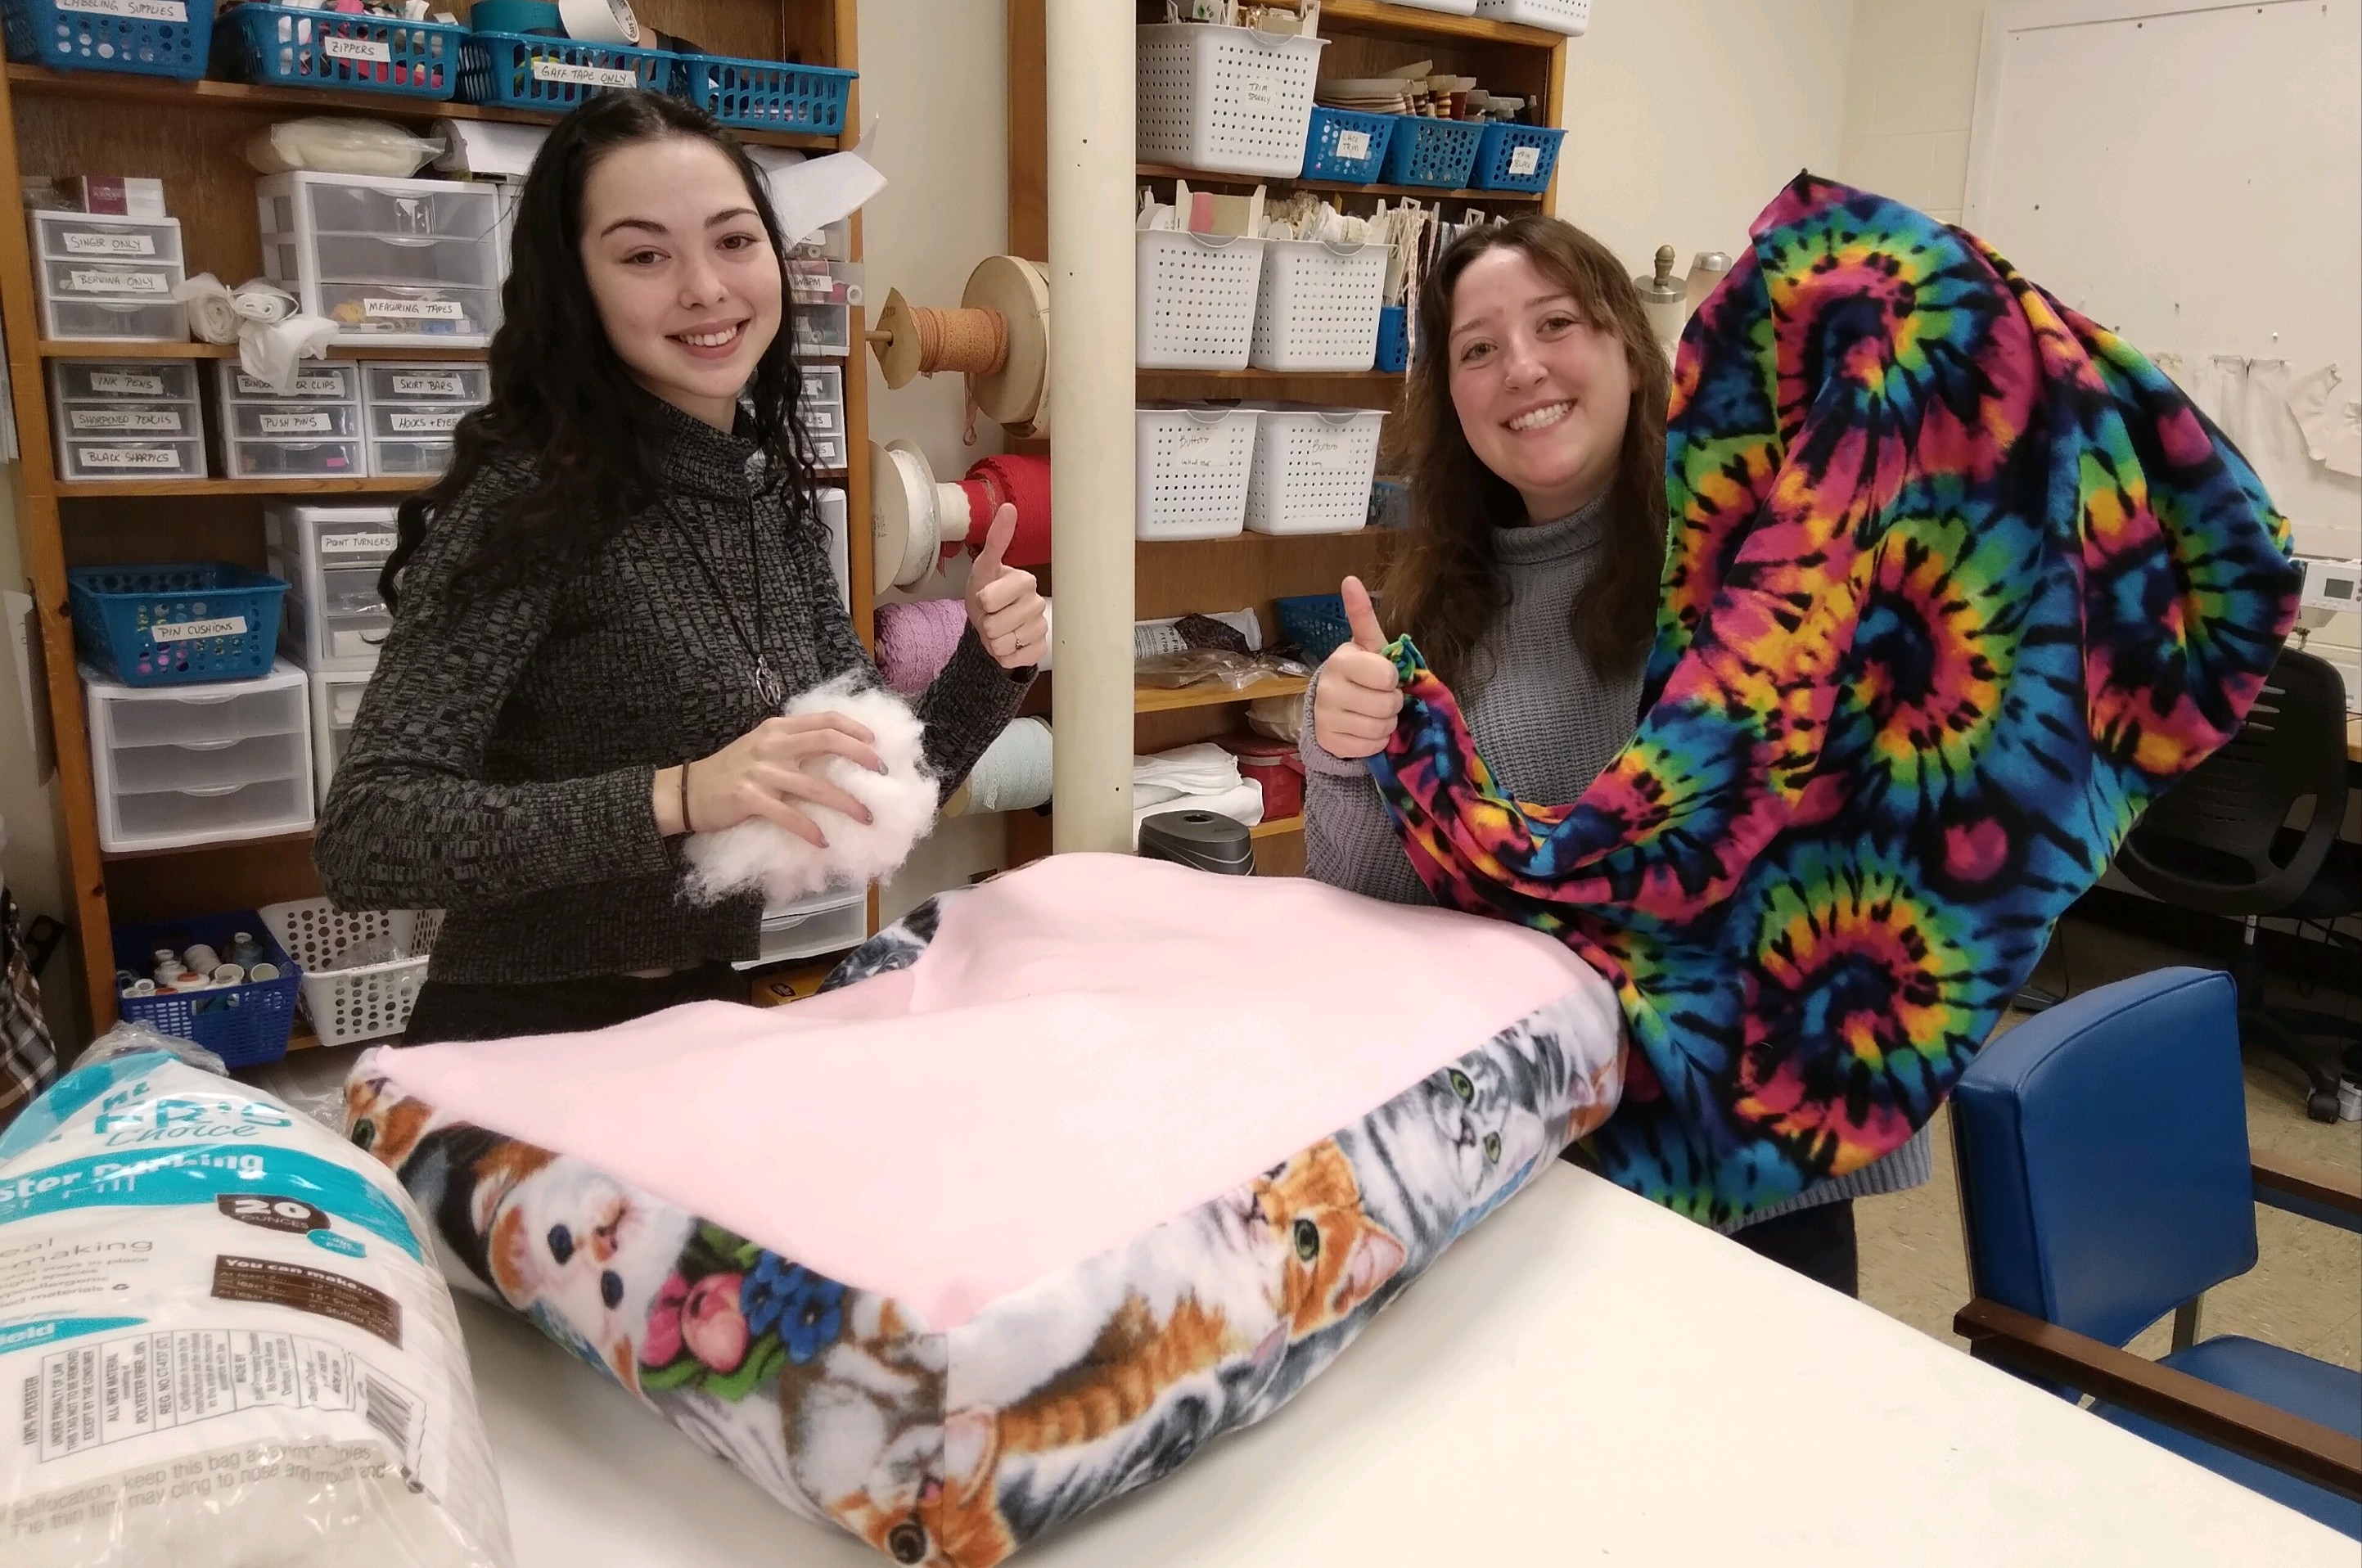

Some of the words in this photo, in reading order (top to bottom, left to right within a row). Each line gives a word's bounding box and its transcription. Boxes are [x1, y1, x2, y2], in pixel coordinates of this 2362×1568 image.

[128, 2, 174, 17] SUPPLIES
[331, 40, 375, 56] ZIPPERS
[541, 65, 567, 79] GAFF
[571, 70, 595, 81] TAPE
[600, 72, 628, 85] ONLY
[71, 237, 106, 248] SINGER
[112, 240, 142, 250] ONLY
[126, 277, 154, 287] ONLY
[369, 303, 420, 313] MEASURING
[426, 305, 453, 313] TAPES
[98, 377, 117, 386] INK
[124, 377, 154, 389] PENS
[311, 381, 336, 390] CLIPS
[400, 379, 424, 390] SKIRT
[426, 381, 453, 391] BARS
[135, 415, 172, 425] PENCILS
[264, 417, 289, 428] PUSH
[295, 417, 318, 427] PINS
[399, 417, 426, 428] HOOKS
[437, 417, 458, 427] EYES
[88, 451, 120, 462] BLACK
[125, 453, 169, 462] SHARPIES
[354, 538, 391, 547] TURNERS
[158, 627, 181, 637] PIN
[235, 1200, 311, 1219] 20
[241, 1214, 309, 1229] OUNCES
[225, 1259, 264, 1269] You
[267, 1264, 303, 1275] can
[24, 1375, 39, 1421] POLYESTER
[124, 1469, 167, 1489] keep
[173, 1460, 204, 1479] this
[208, 1451, 241, 1471] bag
[128, 1488, 166, 1509] may
[171, 1473, 211, 1498] cling
[216, 1472, 235, 1489] to
[240, 1462, 280, 1485] nose
